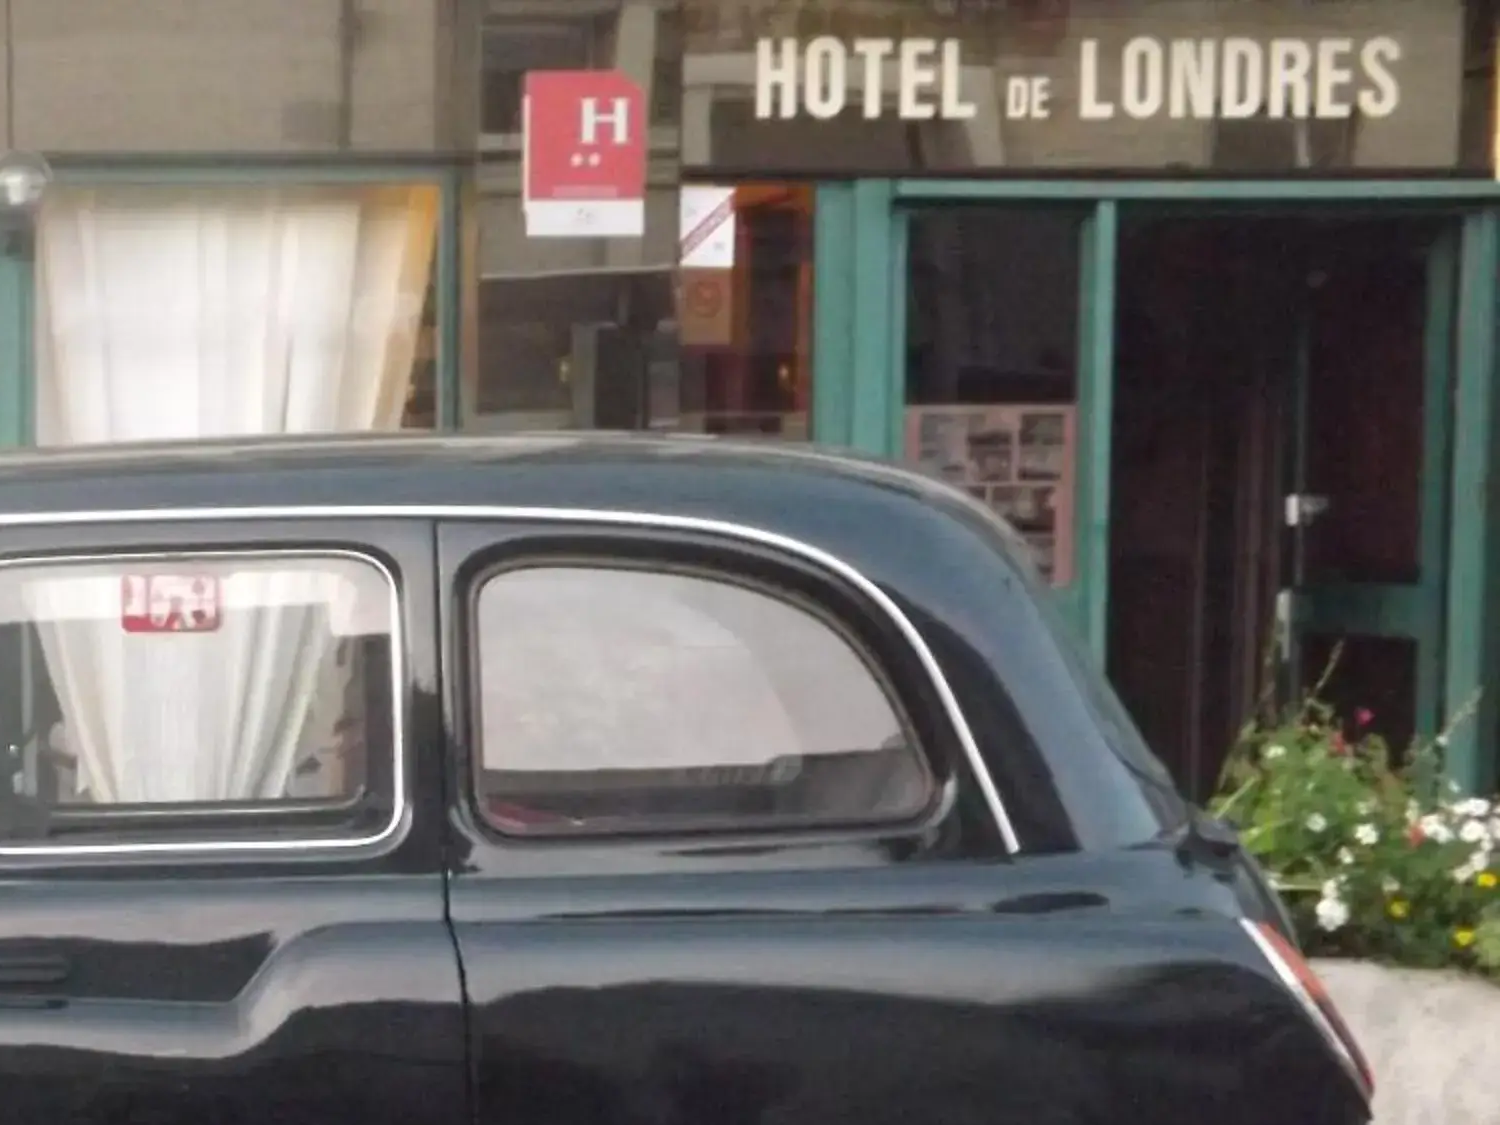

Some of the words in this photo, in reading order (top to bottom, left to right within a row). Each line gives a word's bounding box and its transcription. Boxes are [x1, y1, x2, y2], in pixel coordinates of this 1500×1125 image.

[754, 36, 977, 120] HOTEL
[1006, 75, 1051, 119] DE
[1078, 35, 1403, 120] LONDRES
[579, 96, 630, 146] H
